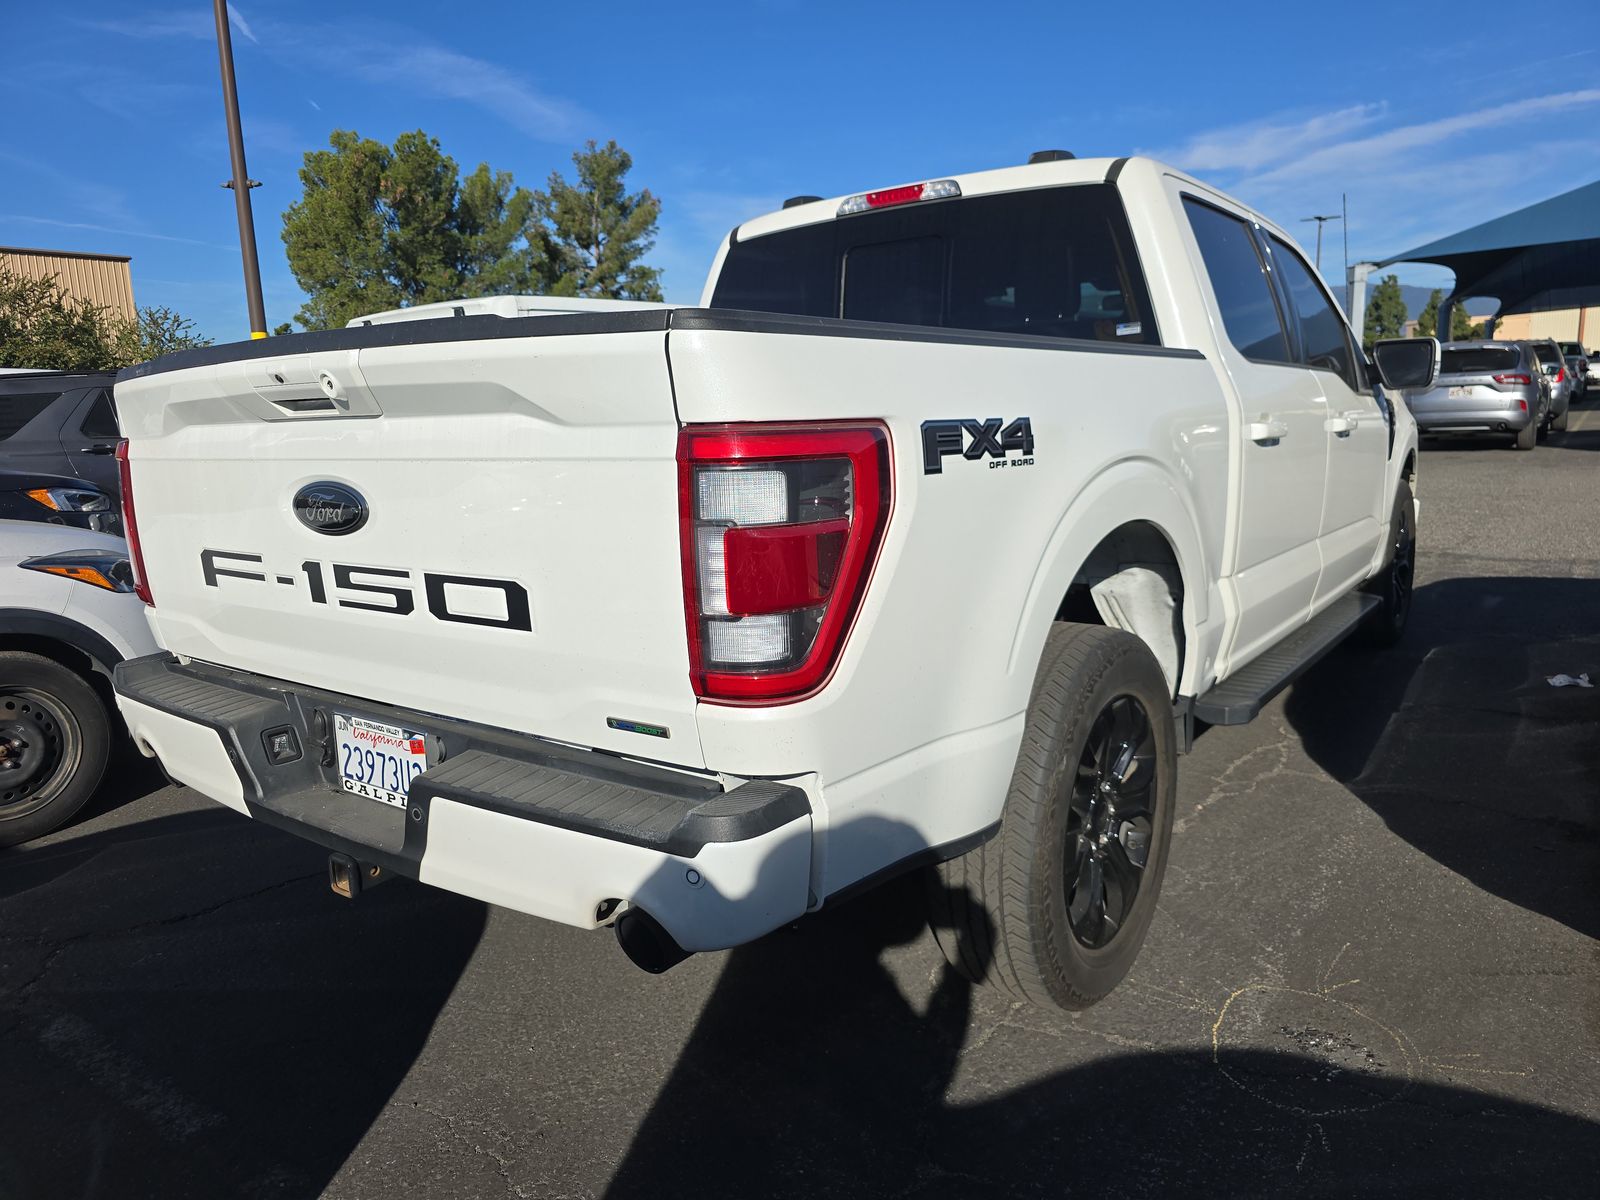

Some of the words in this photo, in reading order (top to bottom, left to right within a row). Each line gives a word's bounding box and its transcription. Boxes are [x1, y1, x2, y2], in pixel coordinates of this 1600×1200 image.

[920, 417, 1034, 475] FX4
[989, 460, 1008, 469] OFF
[1011, 458, 1035, 468] ROAD
[305, 492, 346, 522] Ford
[200, 548, 533, 632] F-150
[338, 720, 349, 731] JUN
[354, 719, 363, 727] SAN
[363, 721, 385, 733] FERNANDO
[386, 727, 400, 736] VALLEY
[344, 780, 407, 807] GALPI
